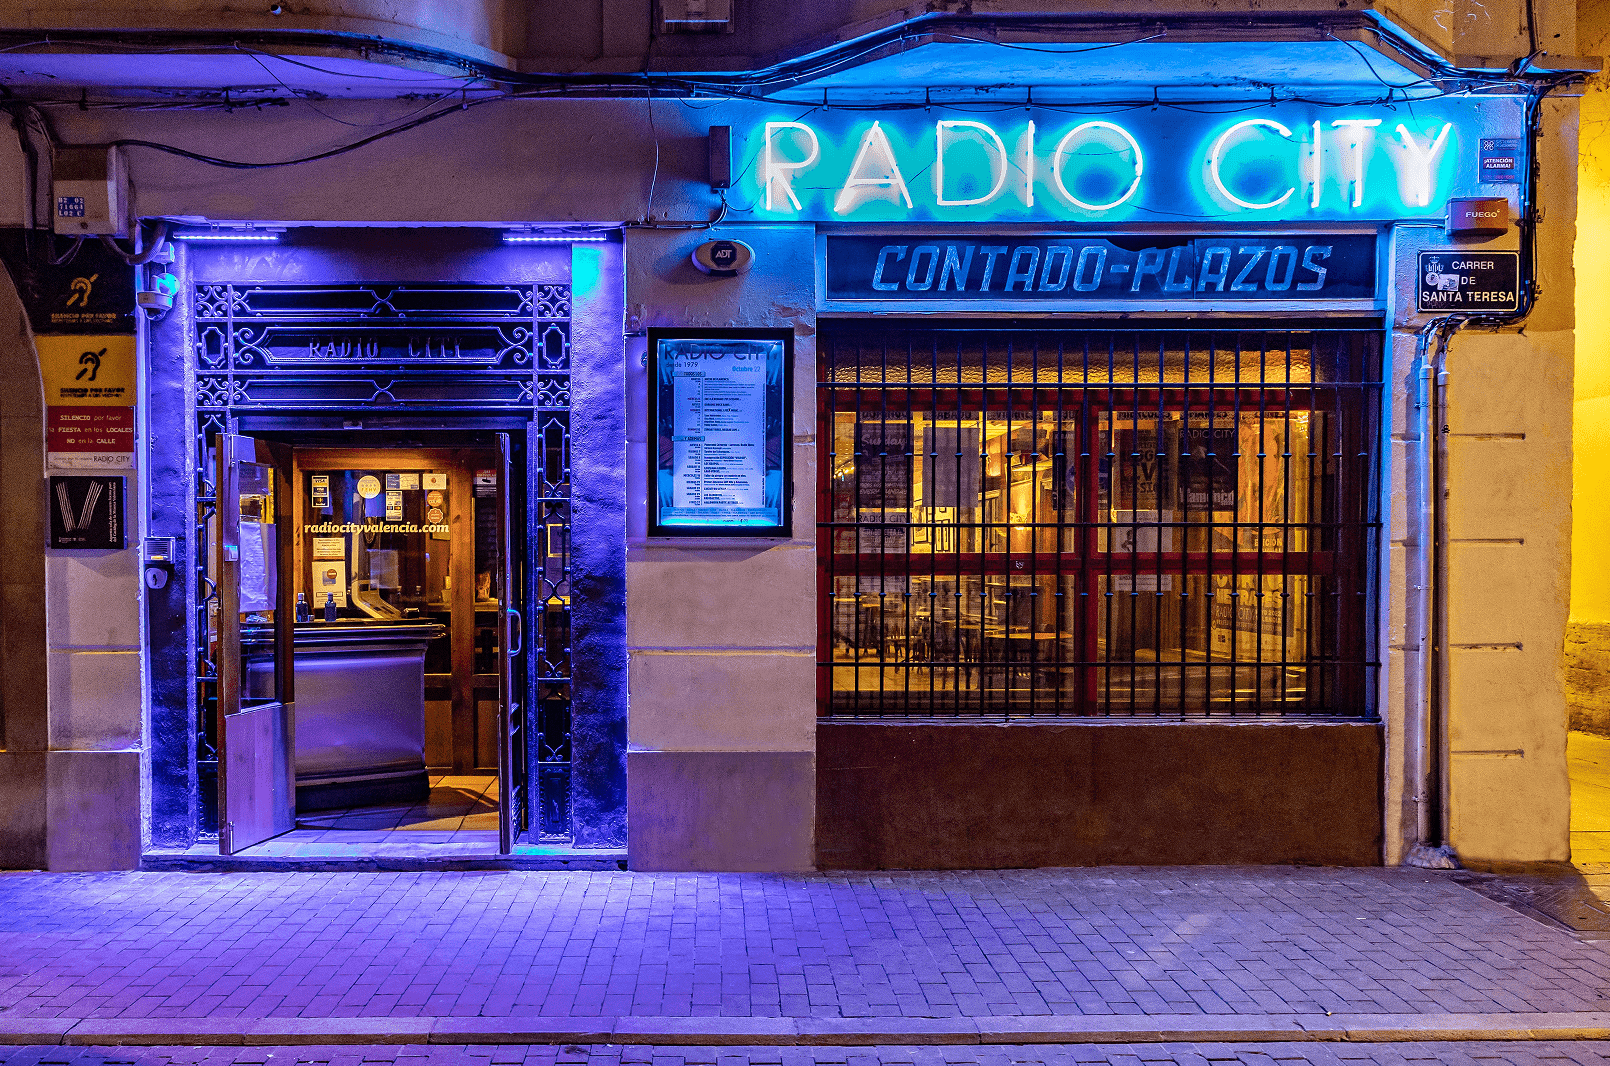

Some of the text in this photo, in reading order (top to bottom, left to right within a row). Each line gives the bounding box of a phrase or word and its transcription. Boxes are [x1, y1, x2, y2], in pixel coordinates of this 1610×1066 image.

[764, 118, 1454, 212] RADIO CITY
[715, 249, 733, 259] ADT
[872, 244, 1334, 293] CONTADO-PLAZOS
[1451, 260, 1495, 270] CARRER
[1461, 276, 1477, 285] DE
[1422, 291, 1515, 302] SANTA TERESA
[308, 337, 463, 358] RADIO CITY
[664, 343, 774, 361] RADIO CITY
[731, 365, 754, 373] Octubre
[304, 521, 450, 535] radiocityvalencia.com
